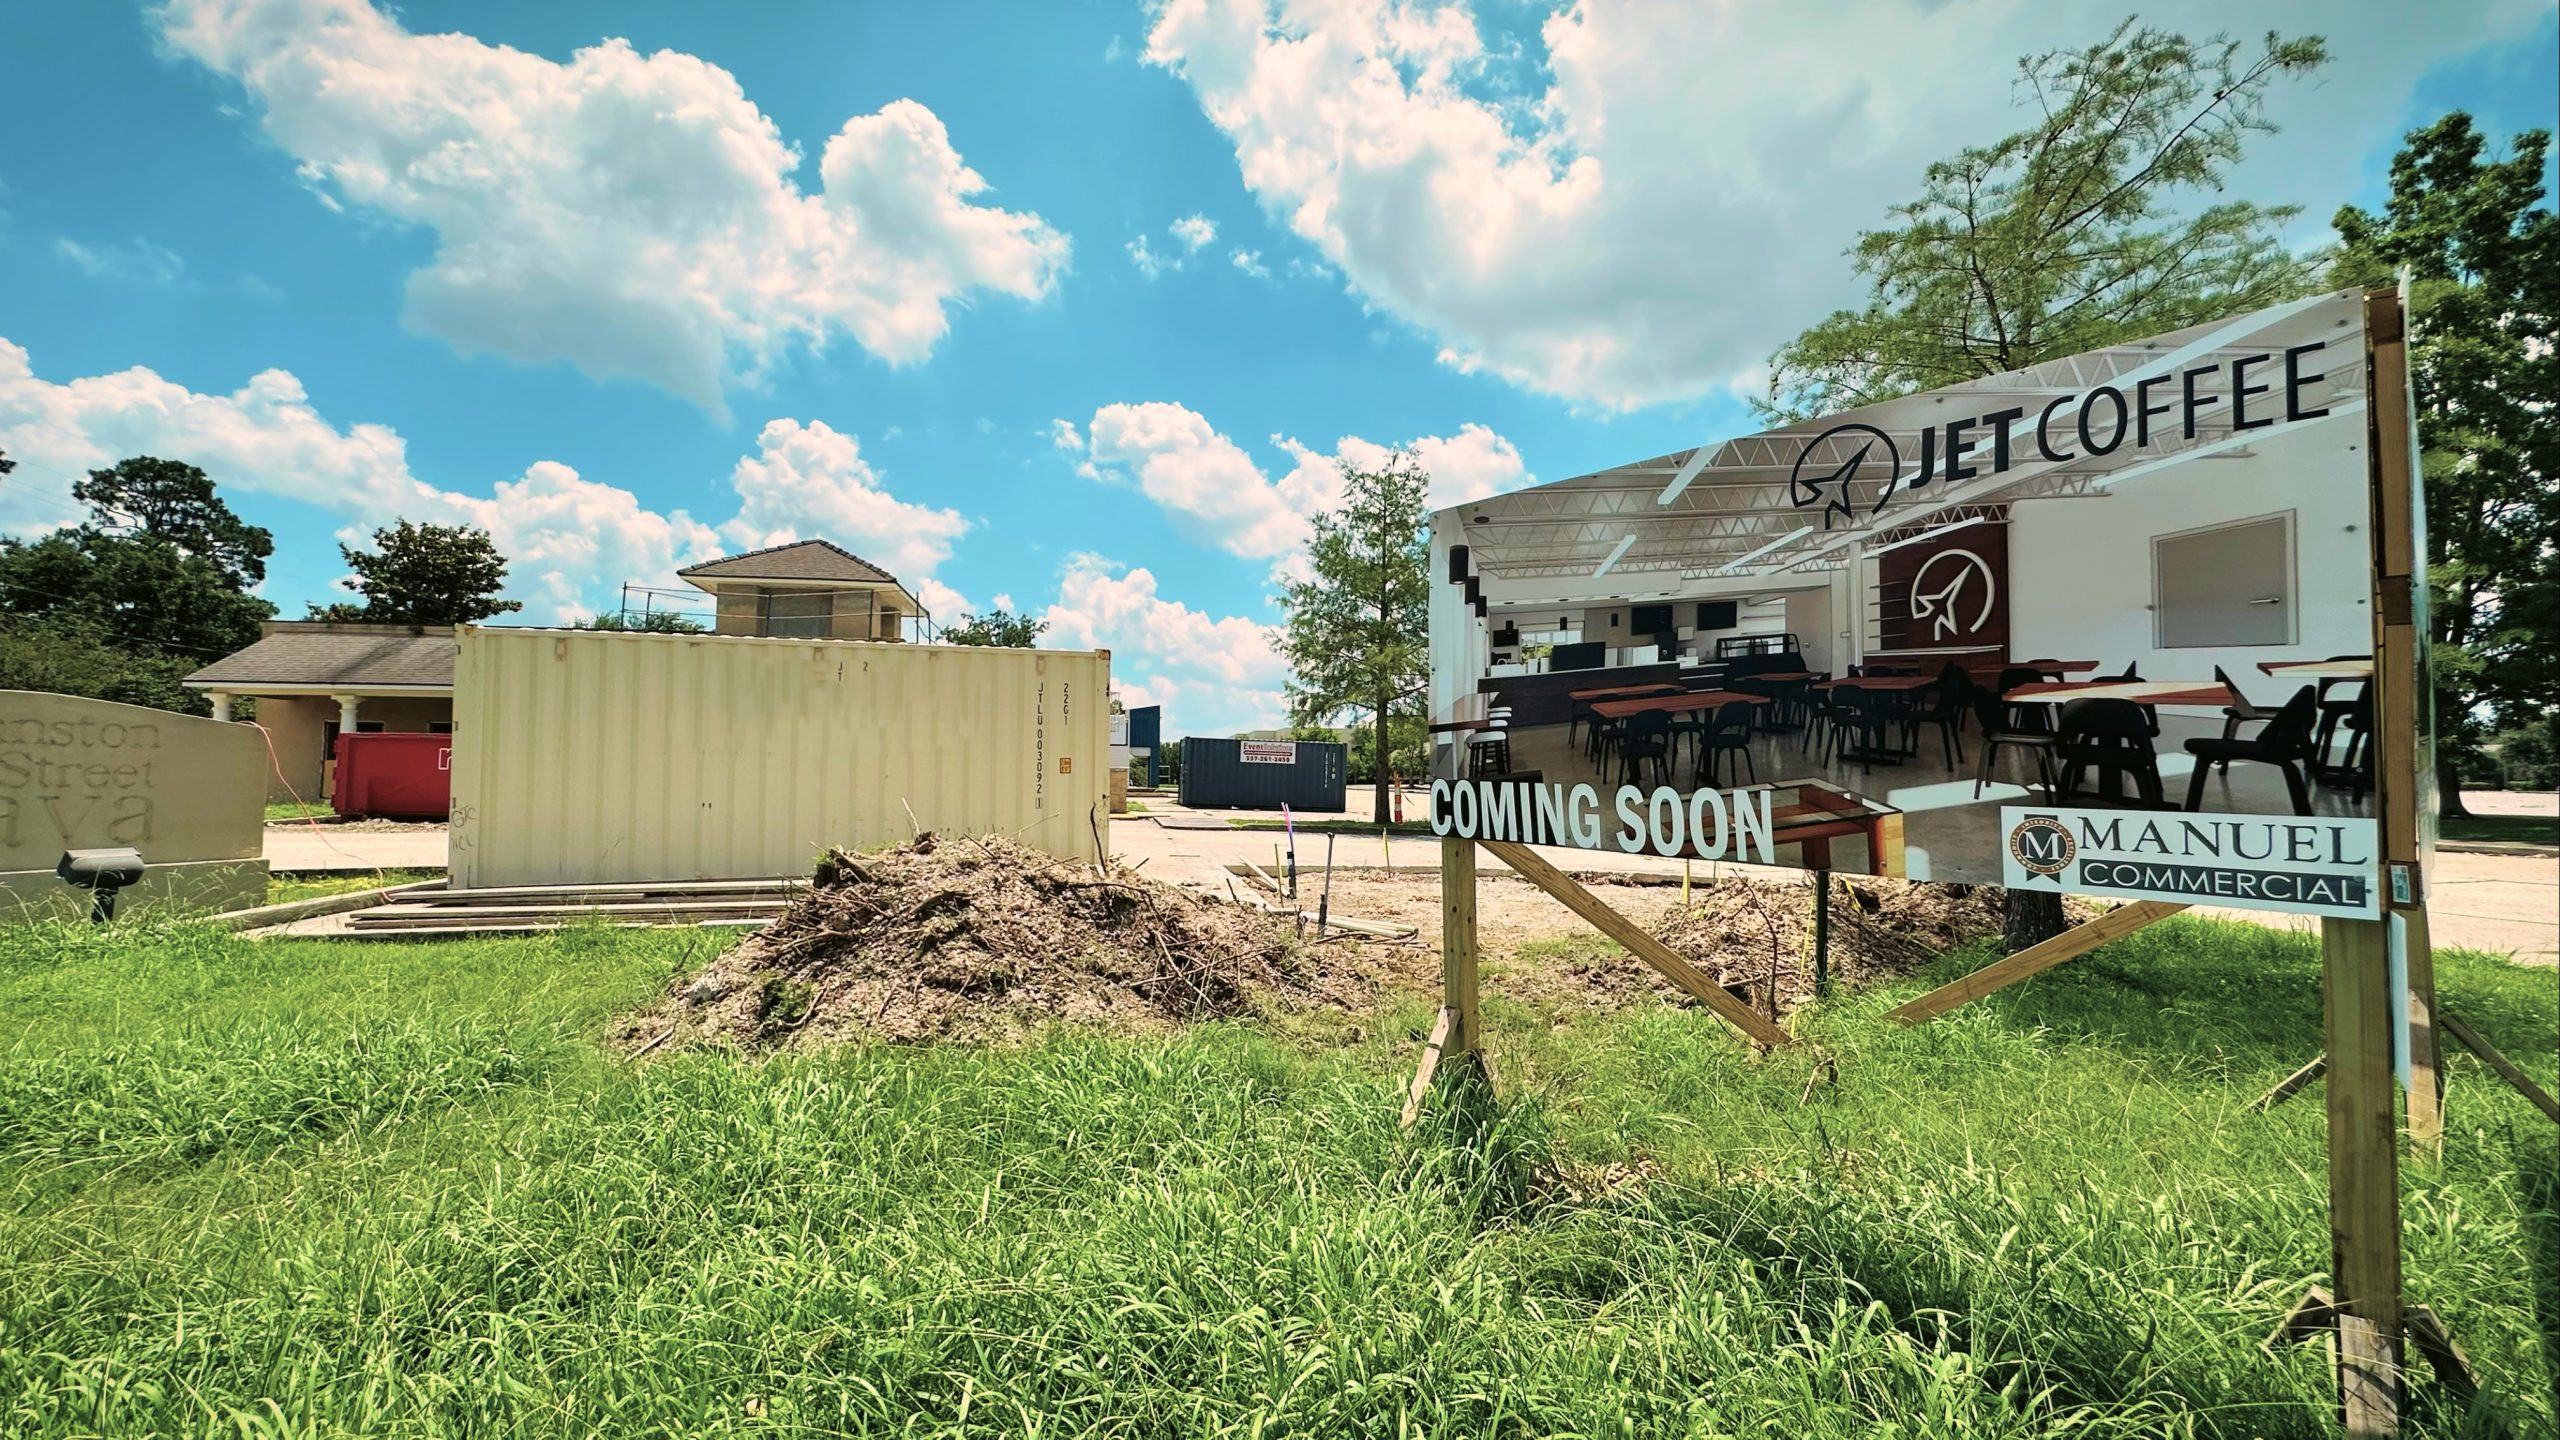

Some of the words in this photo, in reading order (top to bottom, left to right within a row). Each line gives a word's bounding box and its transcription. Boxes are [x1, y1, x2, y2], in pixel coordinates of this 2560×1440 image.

[1910, 406, 2023, 490] JET
[2036, 341, 2330, 463] COFFEE
[0, 715, 162, 749] nston
[0, 750, 160, 789] Street
[1429, 777, 1601, 850] COMING
[1614, 784, 1776, 865] SOON
[2077, 816, 2368, 866] MANUEL
[2023, 831, 2063, 861] M
[2083, 862, 2362, 905] COMMERCIAL
